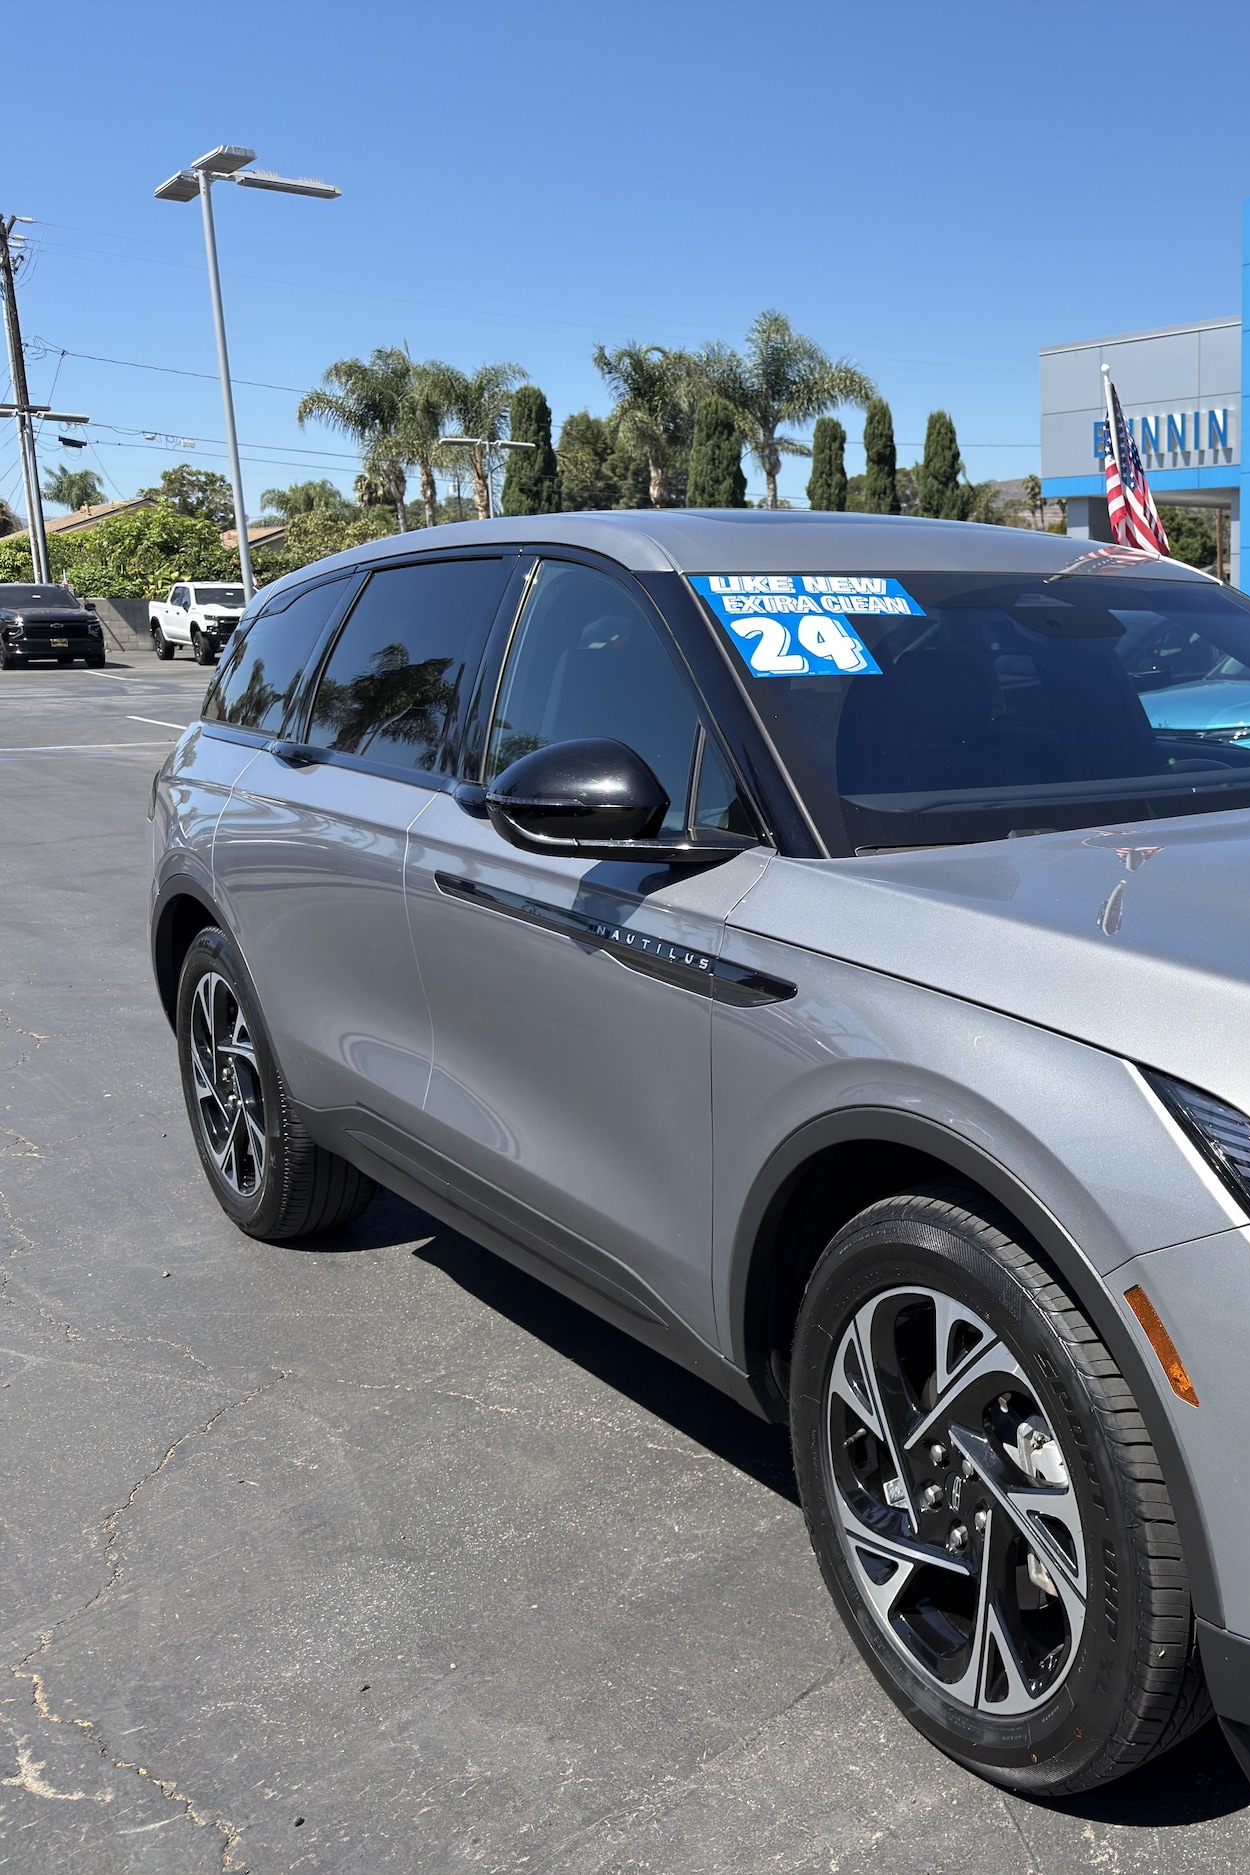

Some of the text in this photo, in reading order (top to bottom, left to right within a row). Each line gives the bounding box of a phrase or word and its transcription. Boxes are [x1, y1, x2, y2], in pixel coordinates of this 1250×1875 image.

[708, 576, 887, 595] LIKE NEW
[721, 595, 913, 615] EXTRA CLEAN
[730, 615, 868, 674] 24
[595, 924, 711, 970] NAUTILUS
